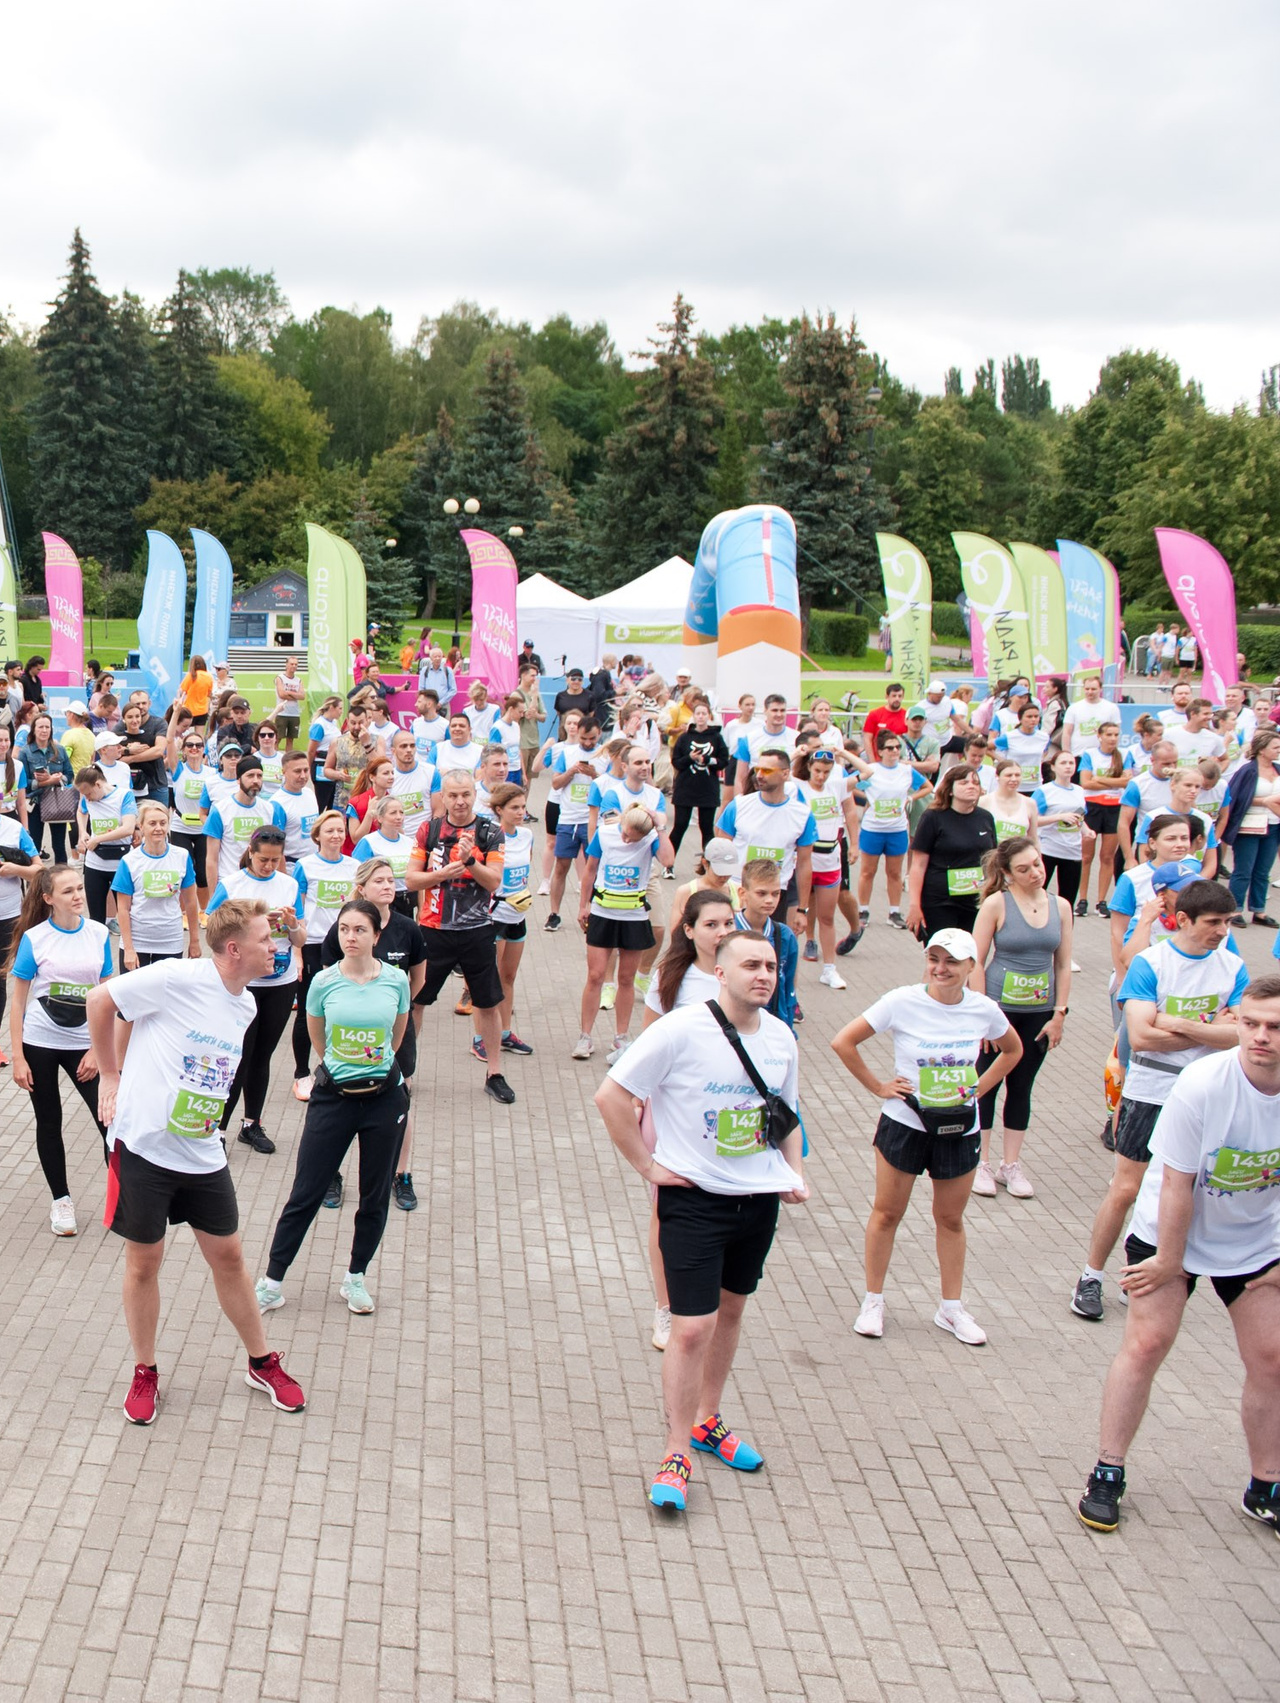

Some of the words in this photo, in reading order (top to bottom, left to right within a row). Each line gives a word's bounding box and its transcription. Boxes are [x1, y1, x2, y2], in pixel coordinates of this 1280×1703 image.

[95, 820, 114, 828] 1090
[240, 818, 258, 827] 1174
[1002, 822, 1021, 833] 1164
[756, 848, 776, 858] 1116
[607, 866, 634, 876] 3009
[954, 870, 978, 880] 1582
[150, 873, 172, 881] 1241
[323, 882, 347, 892] 1409
[1012, 975, 1044, 987] 1094
[58, 984, 87, 997] 1560
[1176, 998, 1210, 1012] 1425
[340, 1028, 376, 1043] 1405
[931, 1069, 967, 1083] 1431
[187, 1096, 220, 1115] 1429
[1232, 1151, 1280, 1167] 1430
